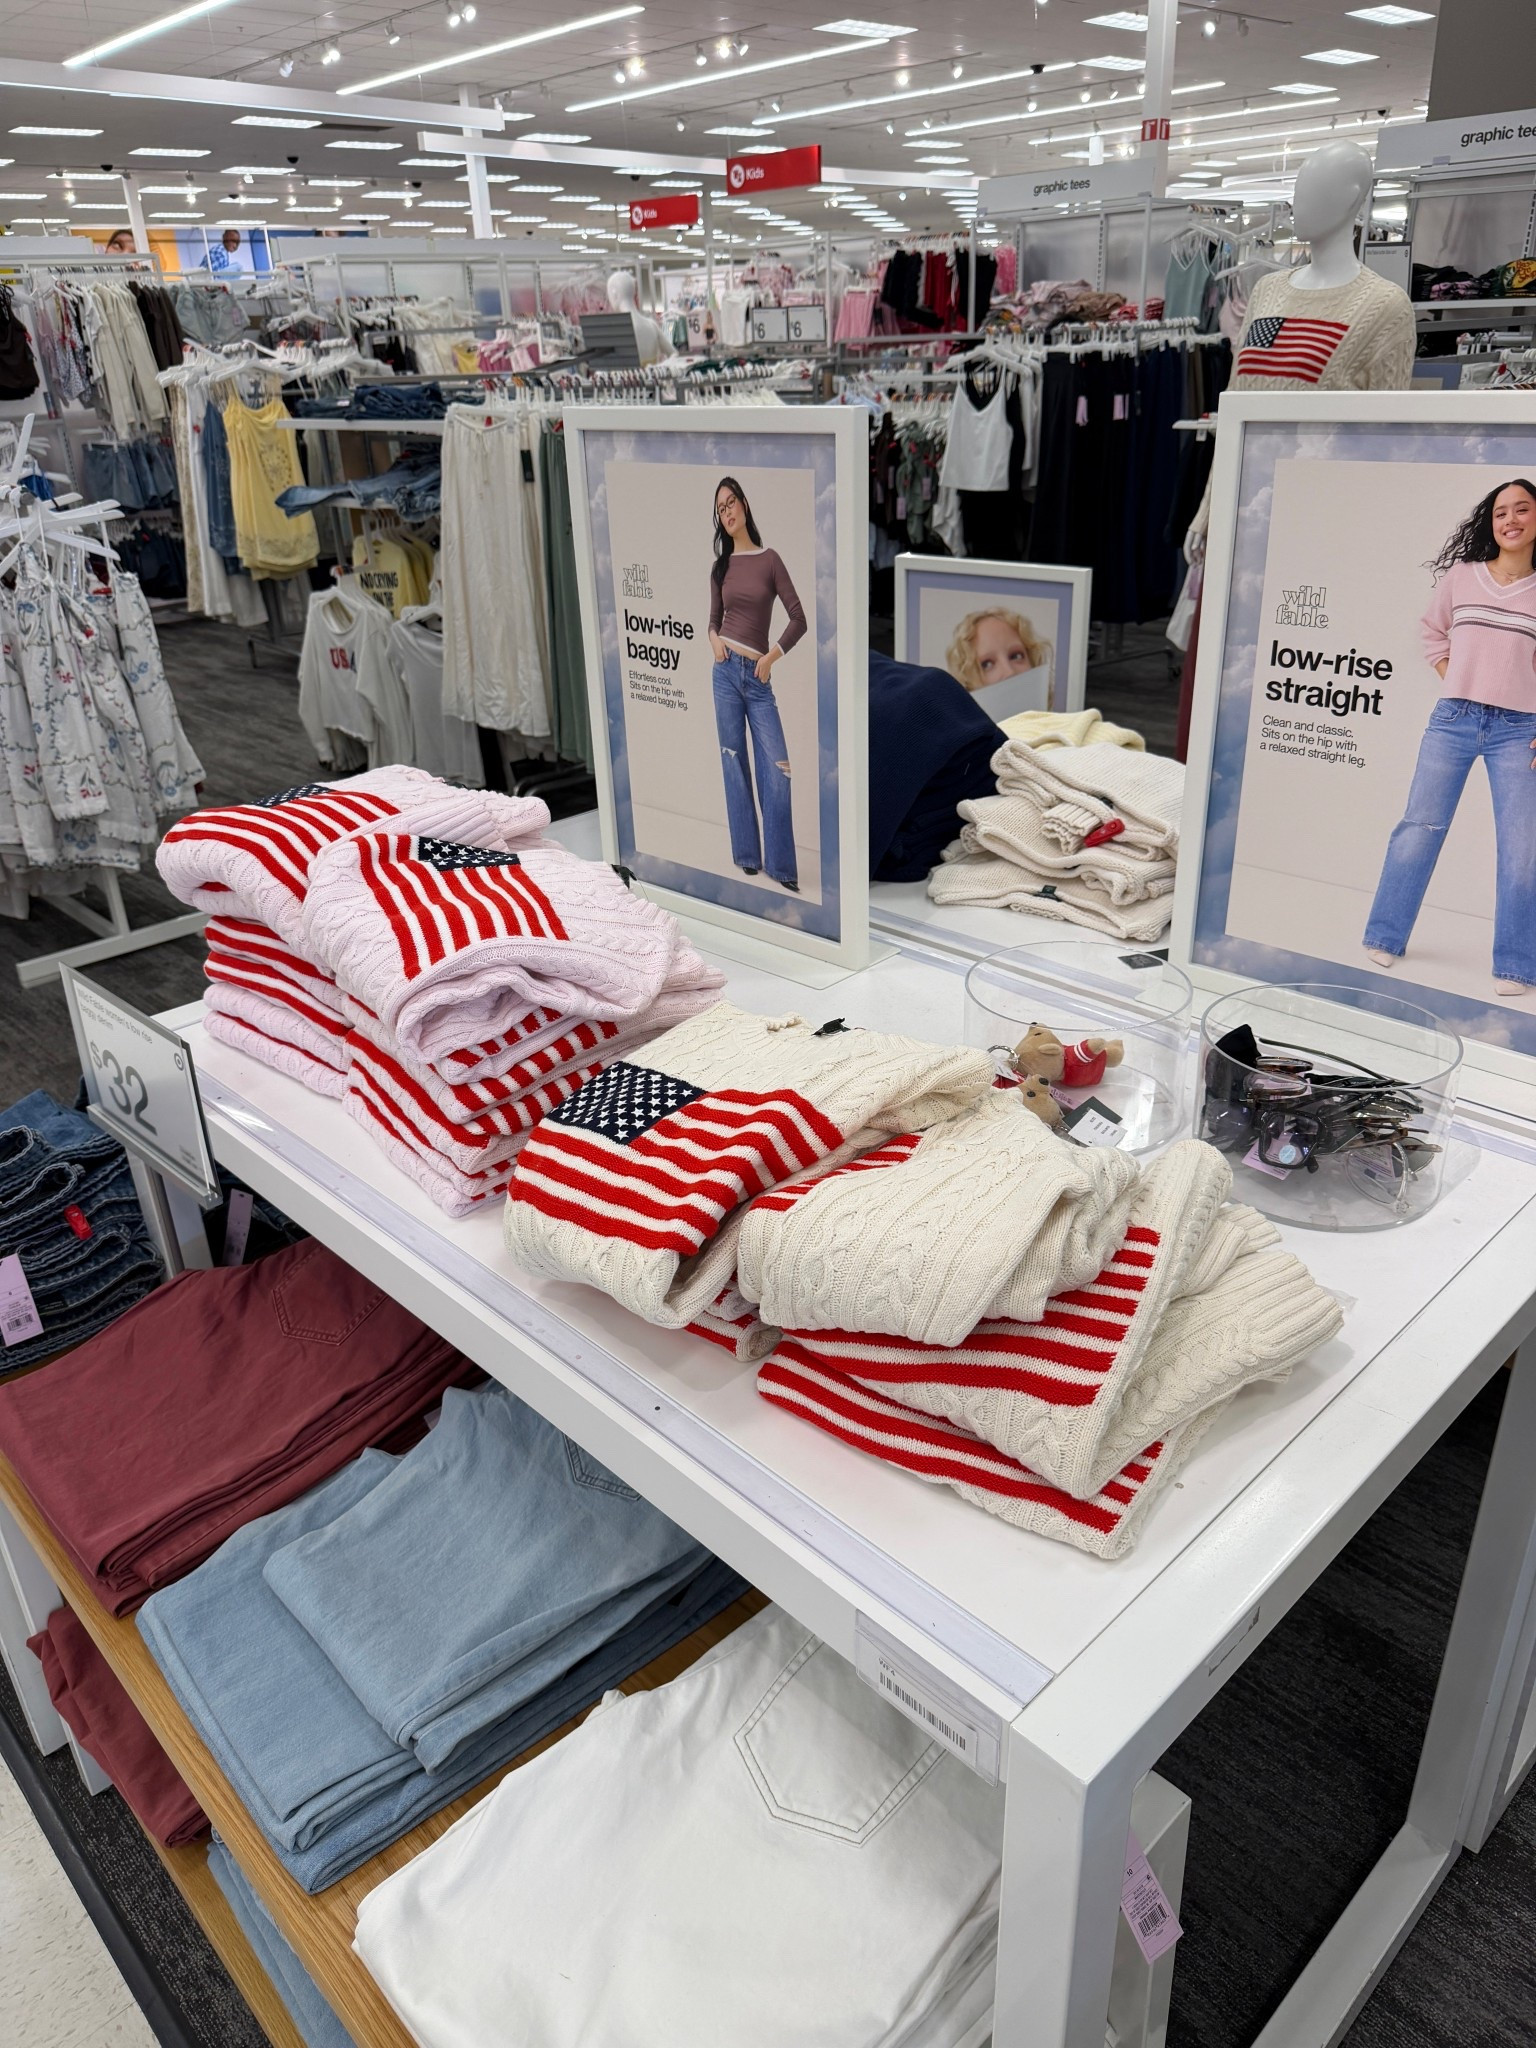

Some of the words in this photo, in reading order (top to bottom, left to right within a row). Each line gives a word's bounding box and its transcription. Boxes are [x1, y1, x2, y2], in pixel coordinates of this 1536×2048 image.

[1461, 126, 1514, 147] graphic
[1518, 124, 1536, 138] tee
[745, 167, 765, 181] Kids
[1033, 180, 1068, 197] graphic
[1070, 179, 1091, 190] tees
[643, 208, 658, 220] Kids
[623, 563, 649, 582] wild
[622, 579, 654, 599] fable
[1282, 585, 1327, 608] wild
[624, 608, 694, 640] low-rise
[1275, 604, 1329, 629] fable
[329, 647, 358, 674] USA
[626, 636, 680, 671] baggy
[1270, 640, 1393, 681] low-rise
[629, 670, 657, 683] Effortless
[657, 677, 672, 686] cool.
[629, 680, 641, 690] Sits
[650, 684, 661, 694] the
[661, 685, 671, 697] hip
[672, 688, 685, 698] with
[636, 692, 657, 704] relaxed
[658, 695, 677, 709] baggy
[1265, 677, 1384, 717] straight
[1262, 715, 1292, 729] Clean
[1294, 722, 1314, 732] and
[1316, 724, 1354, 738] classic.
[1261, 727, 1280, 739] Sits
[1282, 732, 1296, 742] on
[1298, 733, 1315, 745] the
[1317, 736, 1333, 749] hip
[1335, 740, 1358, 752] with
[1259, 741, 1267, 750] a
[1268, 743, 1306, 756] relaxed
[1307, 749, 1346, 764] straight
[1348, 753, 1366, 768] leg.
